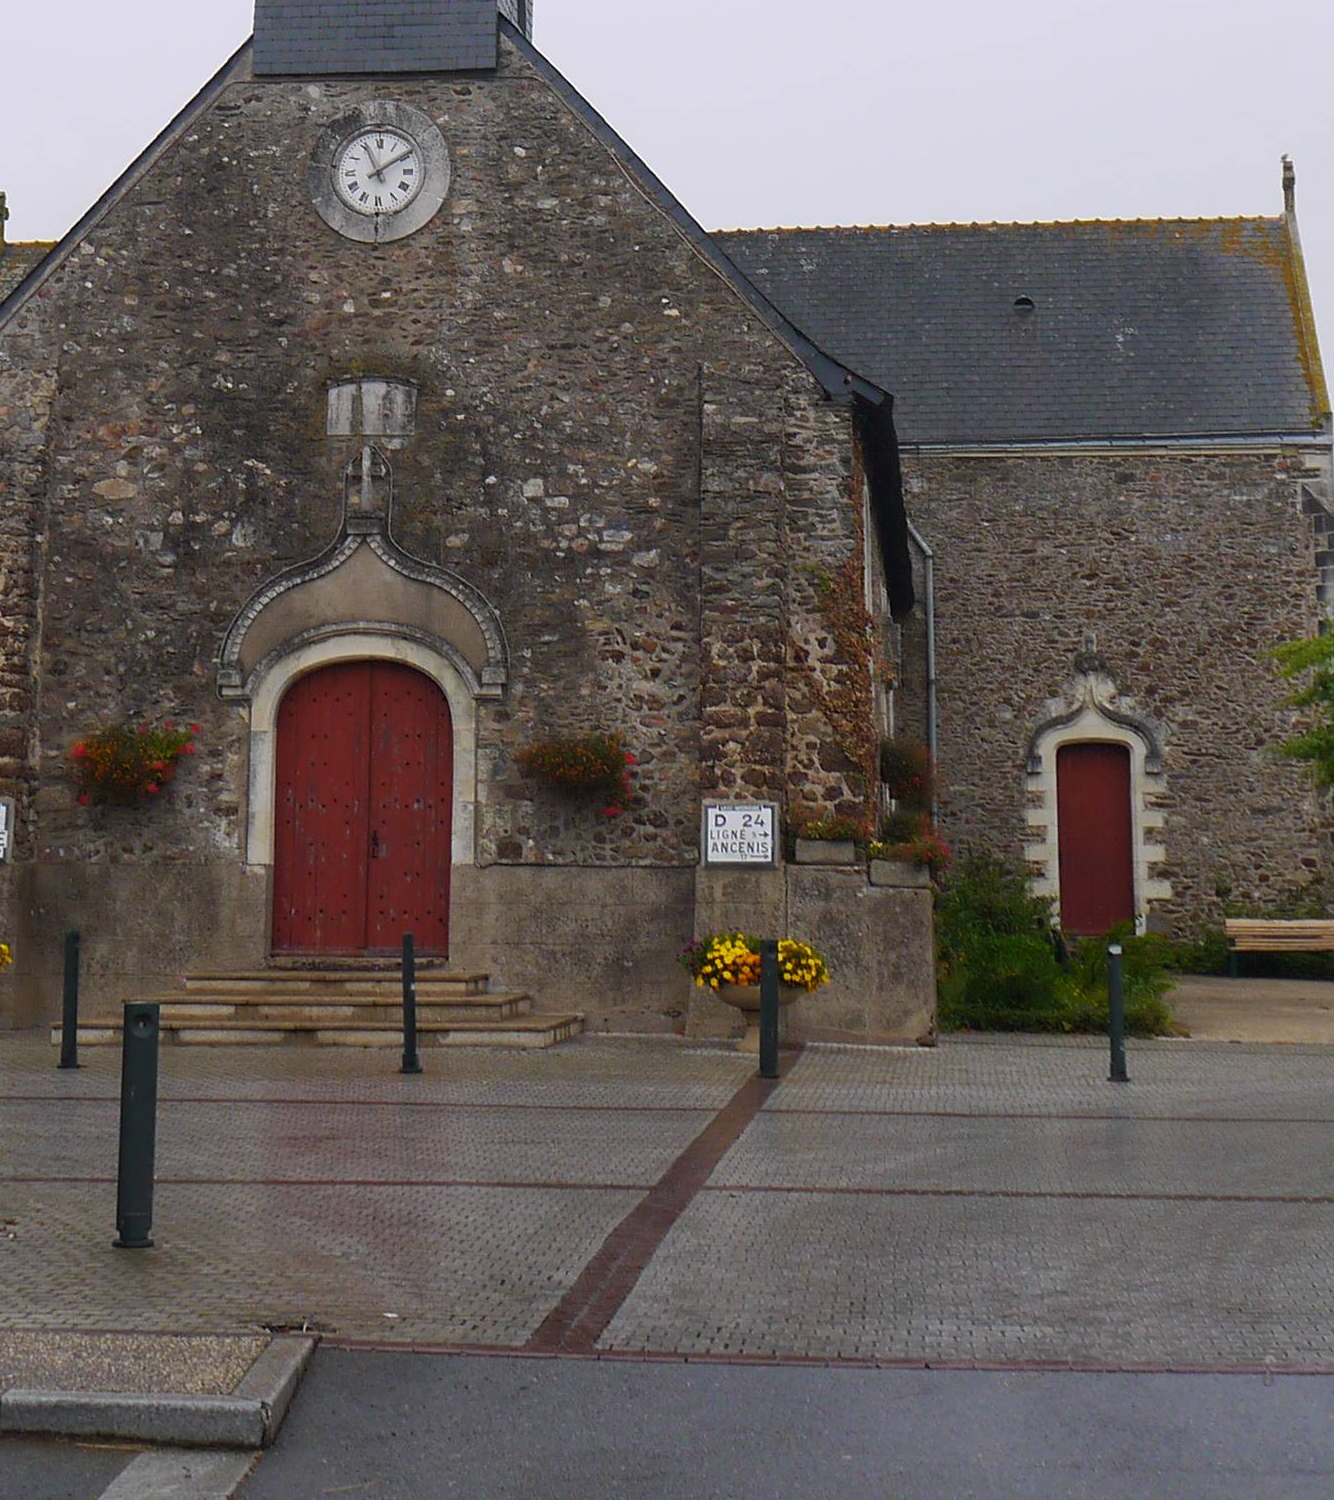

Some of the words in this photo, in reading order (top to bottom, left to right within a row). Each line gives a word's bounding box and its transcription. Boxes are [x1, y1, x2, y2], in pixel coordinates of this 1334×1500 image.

[714, 813, 727, 828] D
[742, 813, 765, 828] 24
[710, 829, 746, 841] LIGNE
[711, 841, 769, 854] ANCENIS
